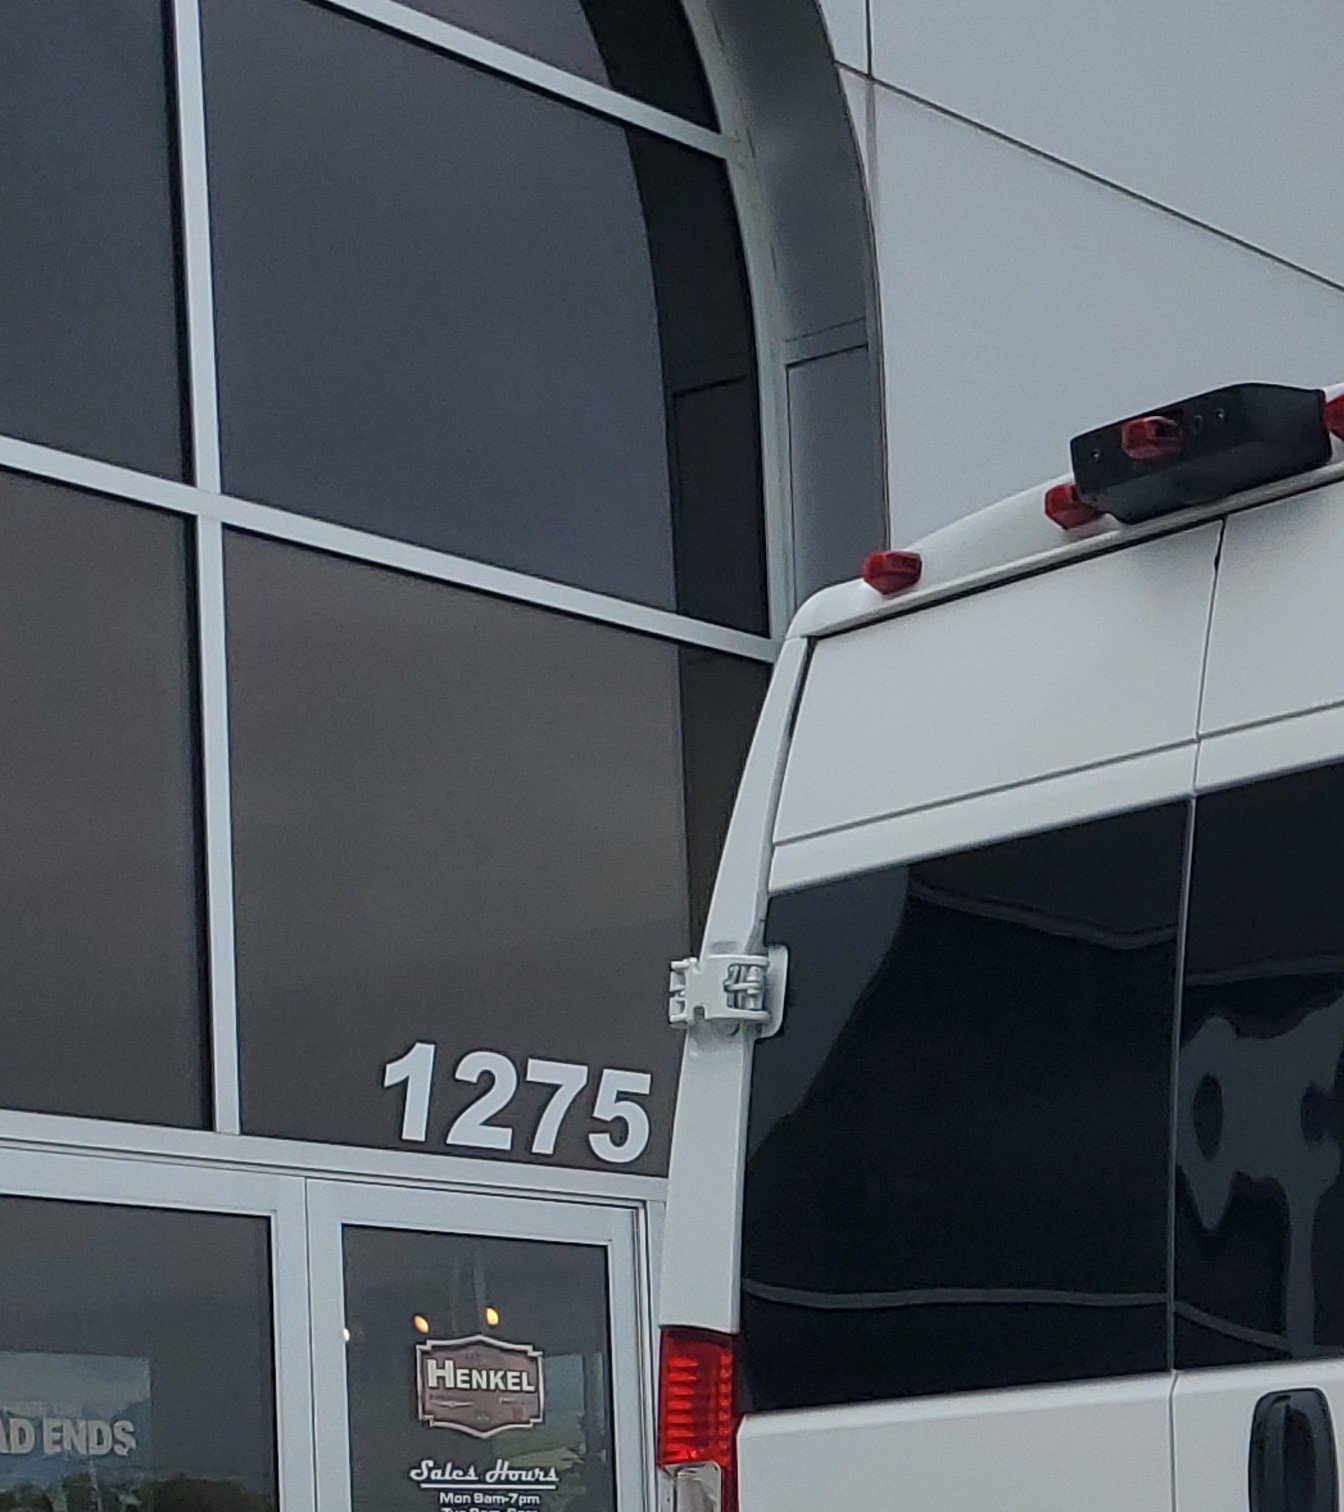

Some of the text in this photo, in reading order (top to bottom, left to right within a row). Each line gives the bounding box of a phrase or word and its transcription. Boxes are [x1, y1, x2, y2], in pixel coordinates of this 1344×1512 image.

[383, 1041, 652, 1164] 1275
[426, 1359, 537, 1392] HENKEL
[43, 1416, 137, 1457] ENDS
[409, 1458, 560, 1483] Sales Hours
[439, 1492, 472, 1504] Mon
